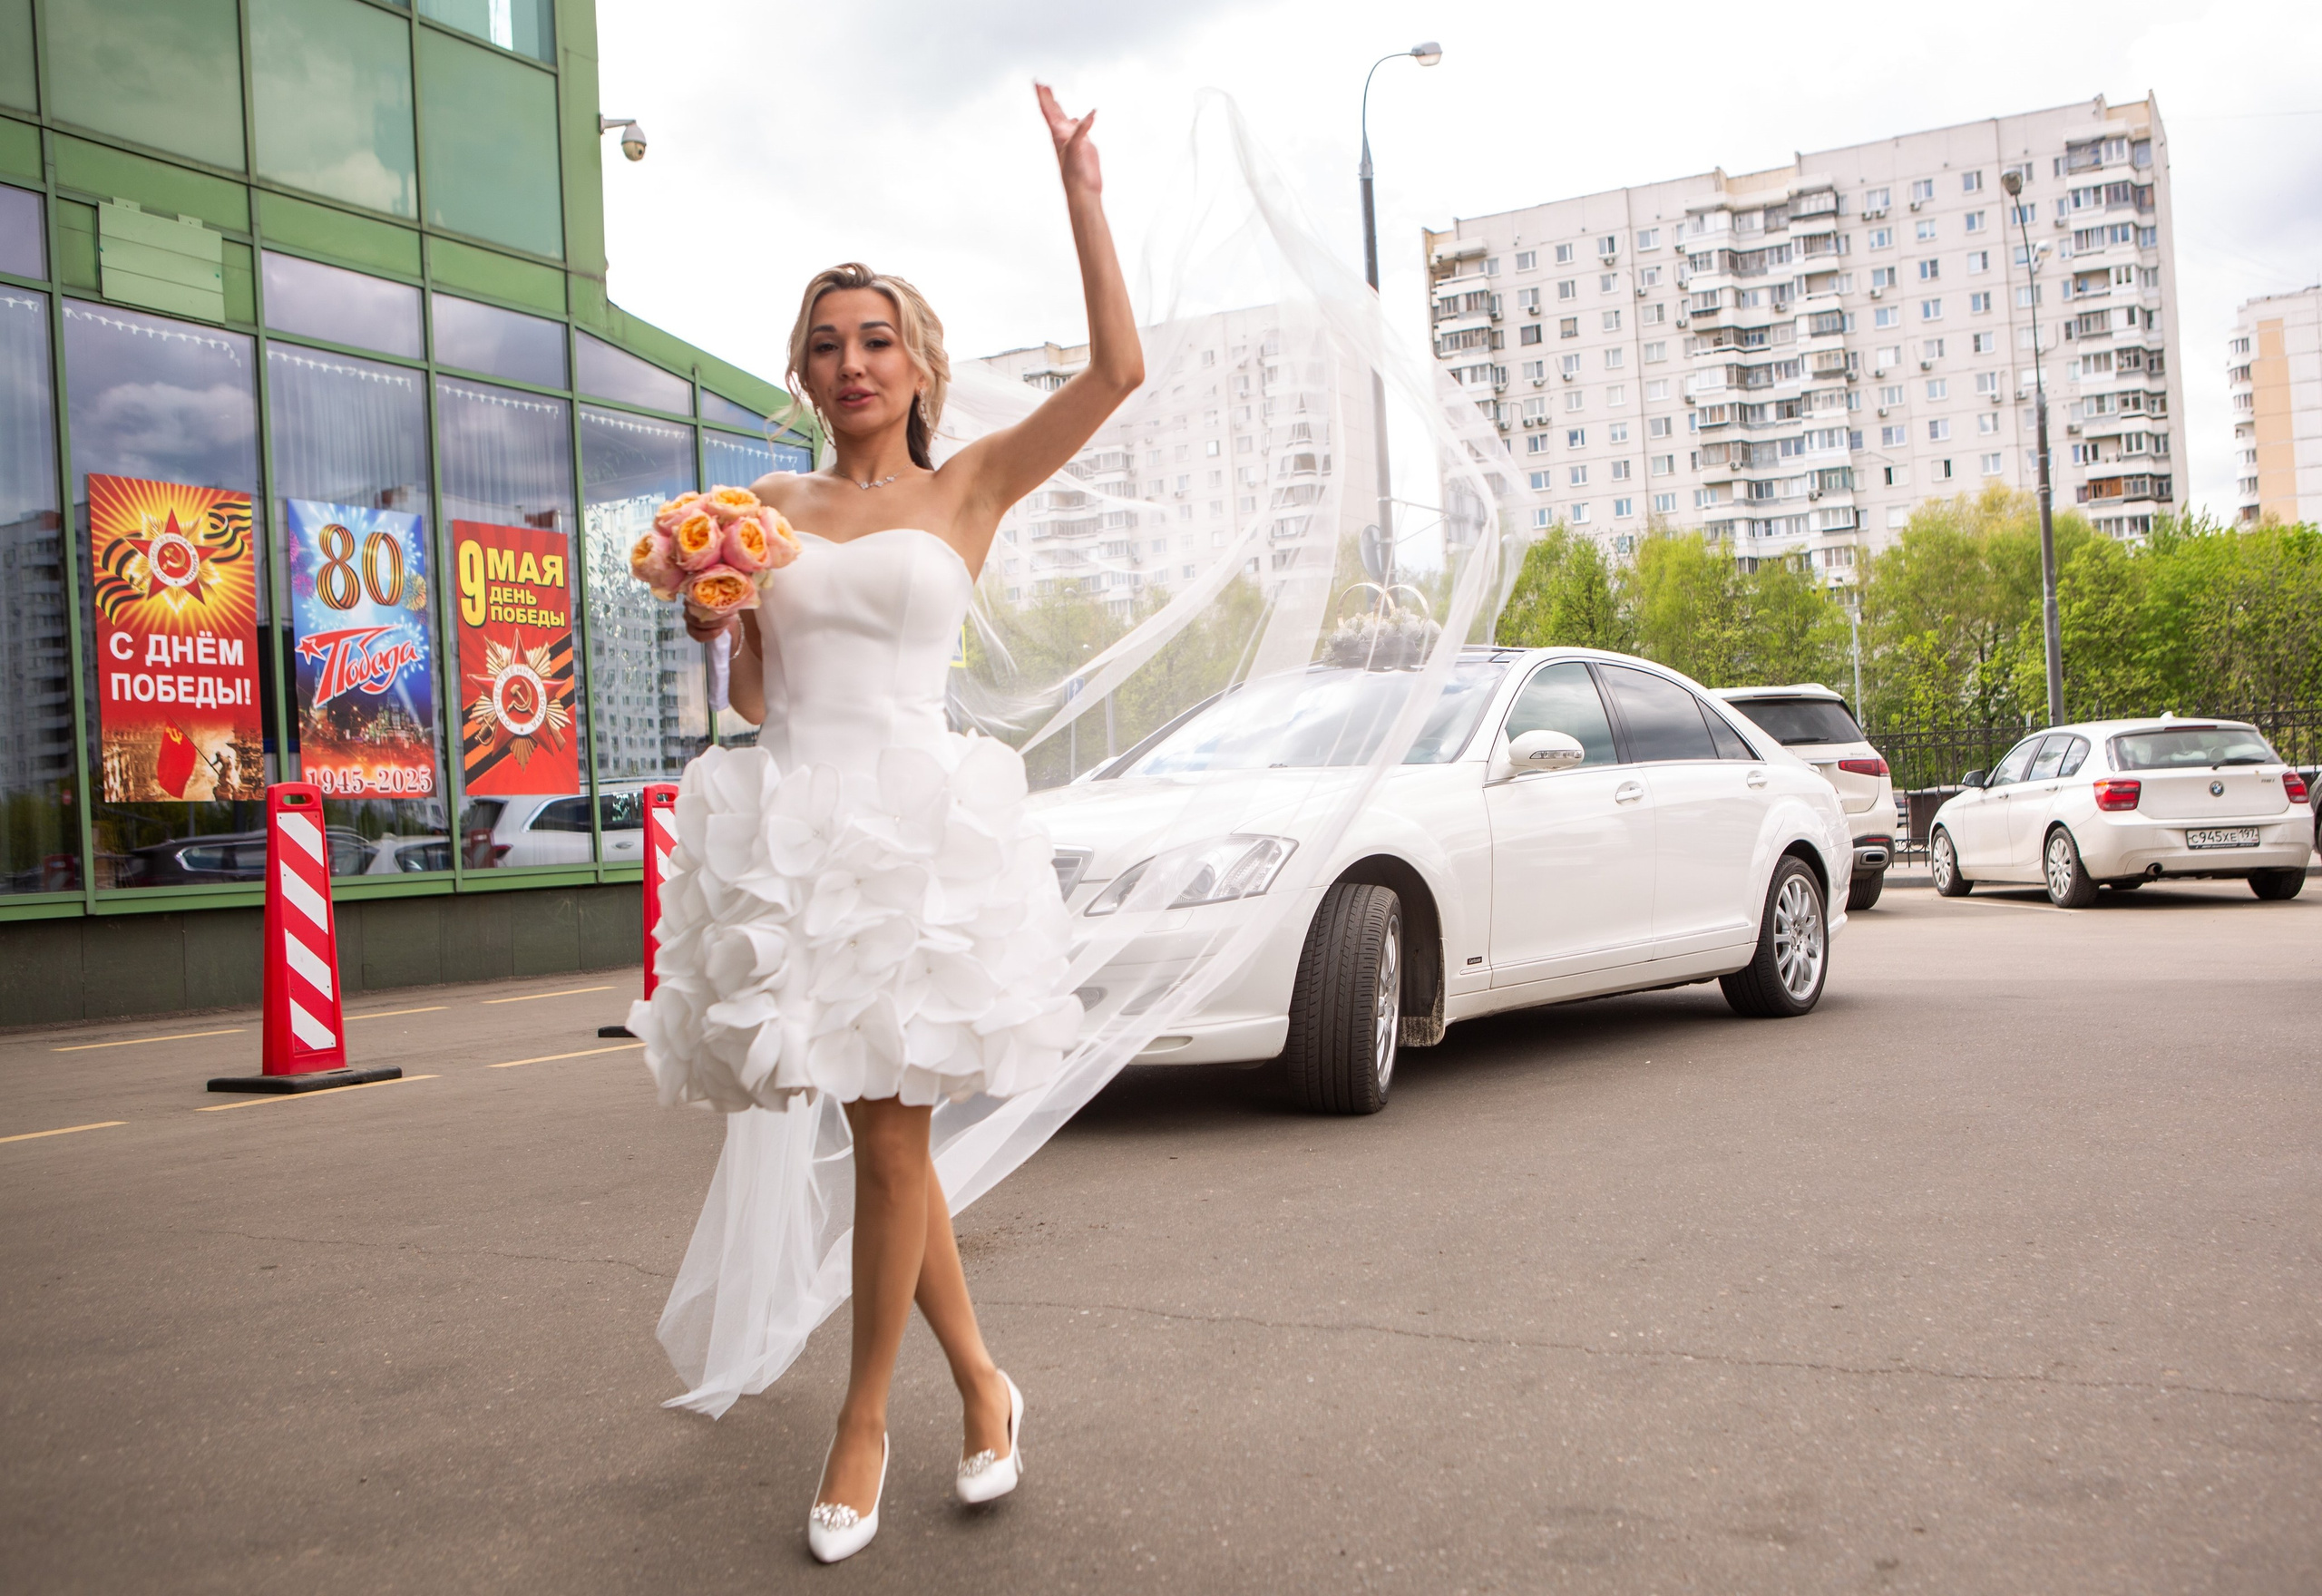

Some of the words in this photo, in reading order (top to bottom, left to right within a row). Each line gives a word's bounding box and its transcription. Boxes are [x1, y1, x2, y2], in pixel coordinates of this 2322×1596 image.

[316, 523, 405, 610] 80
[458, 539, 486, 627] 9
[487, 548, 565, 588] МАЯ
[489, 587, 537, 606] ДЕНЬ
[491, 605, 566, 628] ПОБЕДЫ
[110, 632, 133, 660] С
[145, 631, 245, 667] ДНЁМ
[297, 625, 418, 706] Победа
[111, 673, 252, 708] ПОБЕДЫ!
[306, 766, 433, 793] 1945-2025
